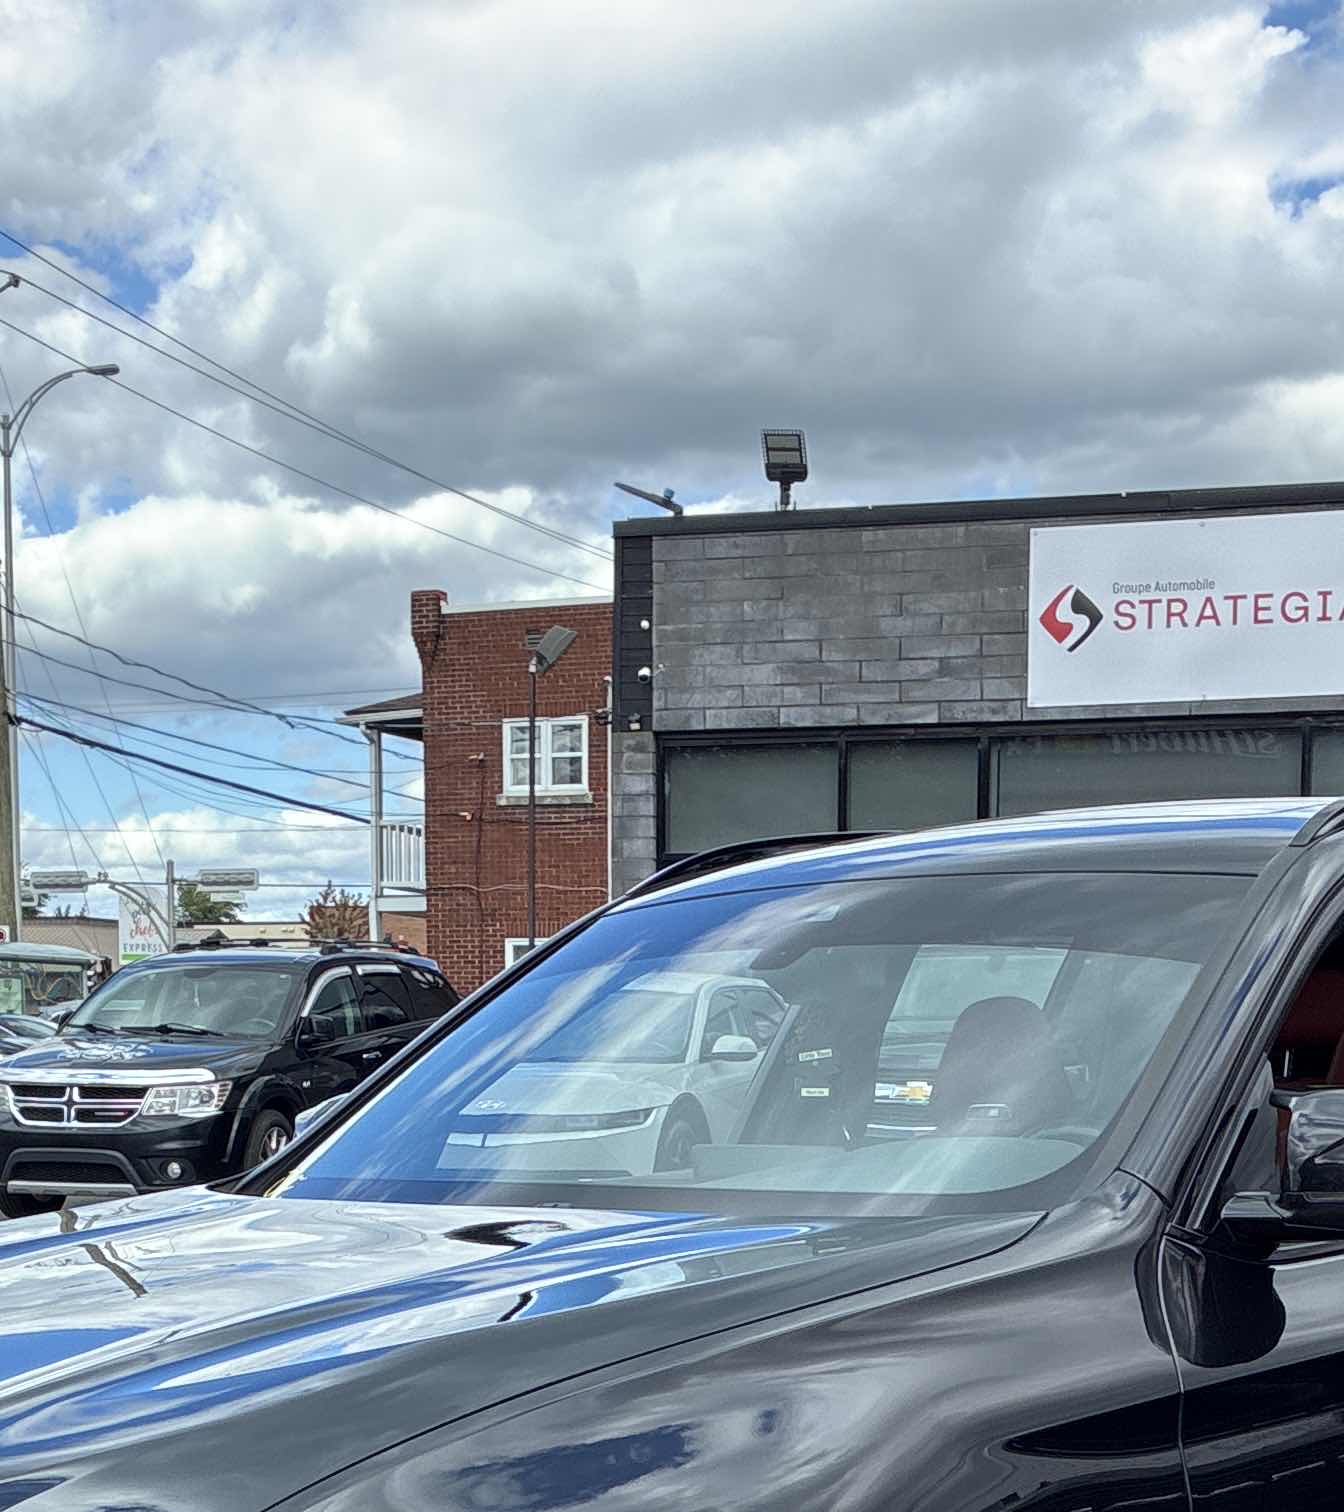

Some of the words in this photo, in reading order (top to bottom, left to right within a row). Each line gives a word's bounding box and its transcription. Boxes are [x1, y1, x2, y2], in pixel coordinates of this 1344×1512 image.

[1112, 581, 1151, 595] Groupe
[1154, 579, 1216, 592] Automobile
[123, 943, 163, 953] EXPRESS
